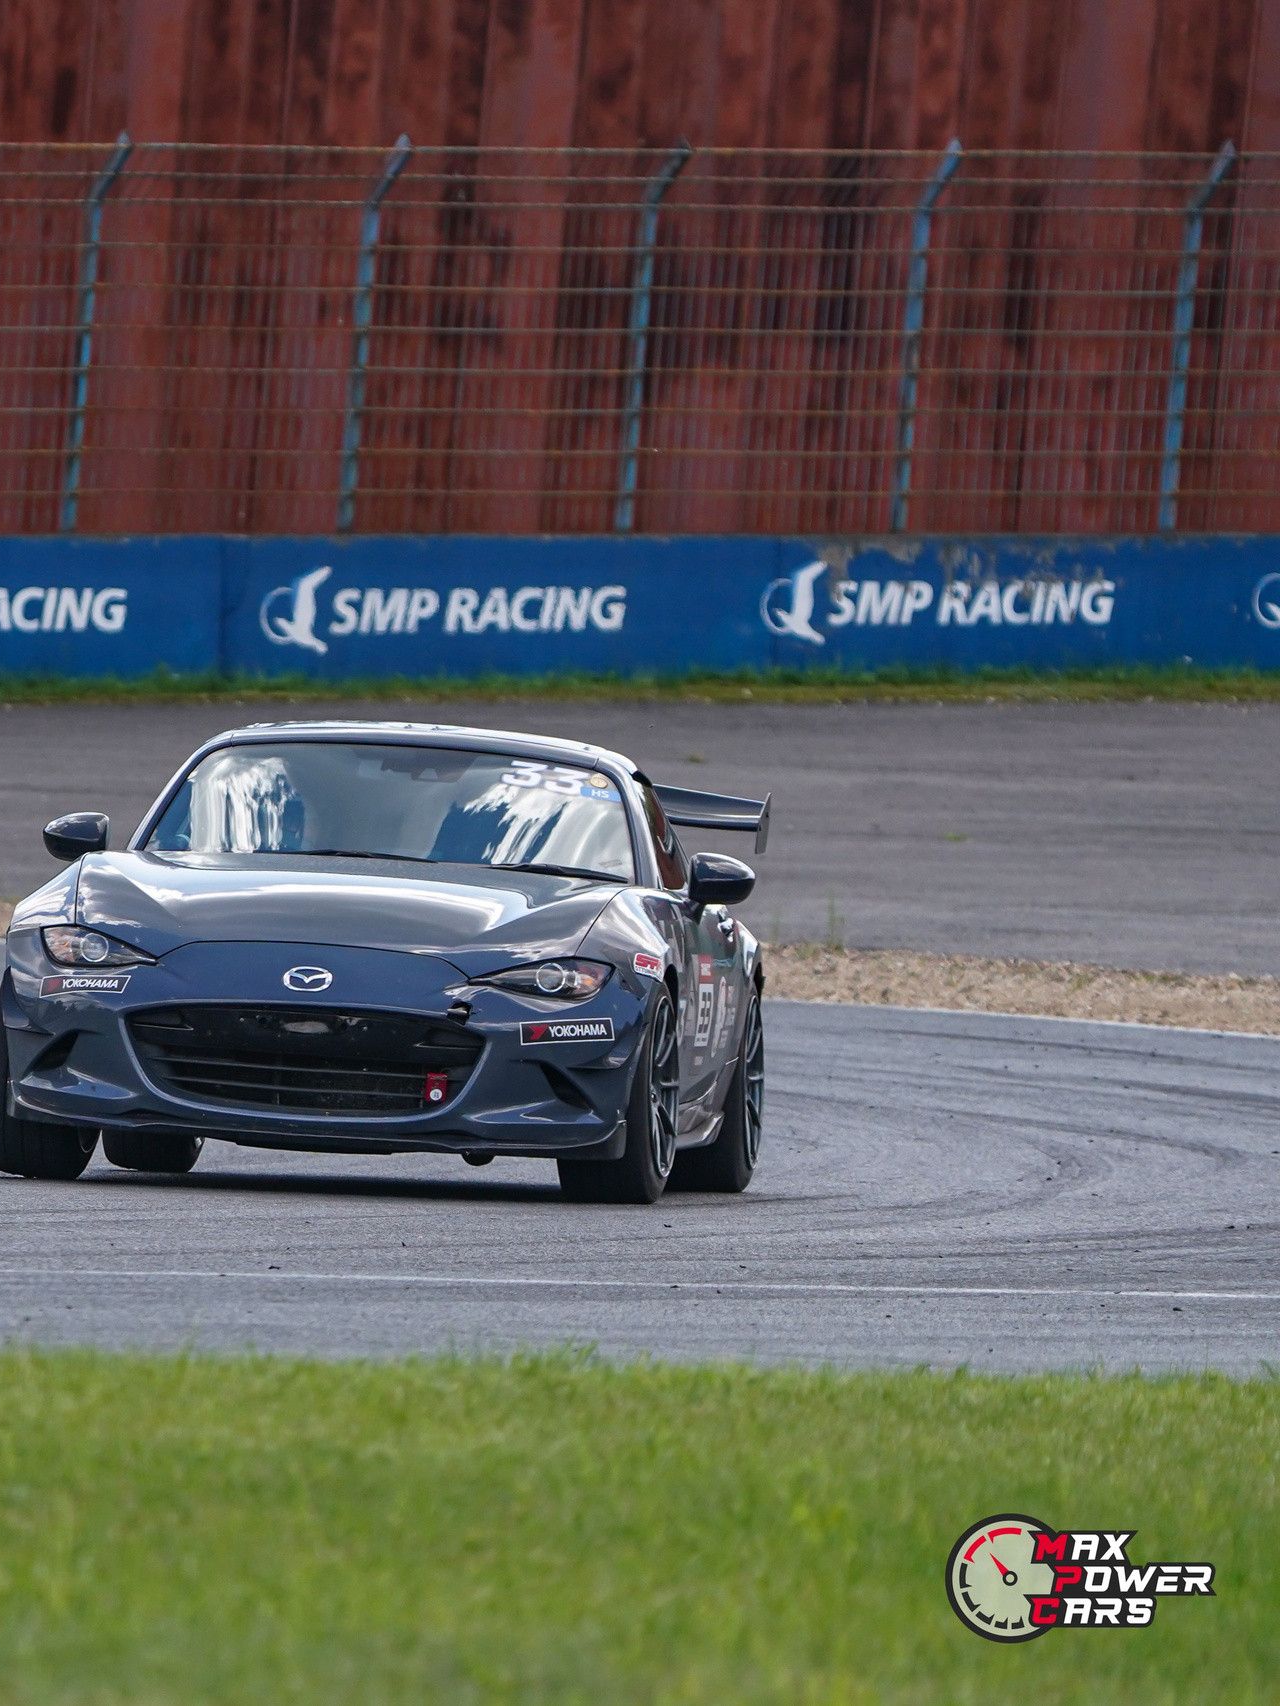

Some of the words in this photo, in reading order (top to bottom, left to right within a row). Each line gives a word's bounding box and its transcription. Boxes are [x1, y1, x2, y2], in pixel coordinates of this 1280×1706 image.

[331, 587, 441, 634] SMP
[445, 586, 627, 633] RACING
[828, 580, 934, 627] SMP
[937, 580, 1116, 627] RACING
[501, 760, 590, 796] 33
[591, 789, 610, 799] HS
[62, 978, 119, 989] YOKOHAMA
[548, 1023, 608, 1038] YOKOHAMA
